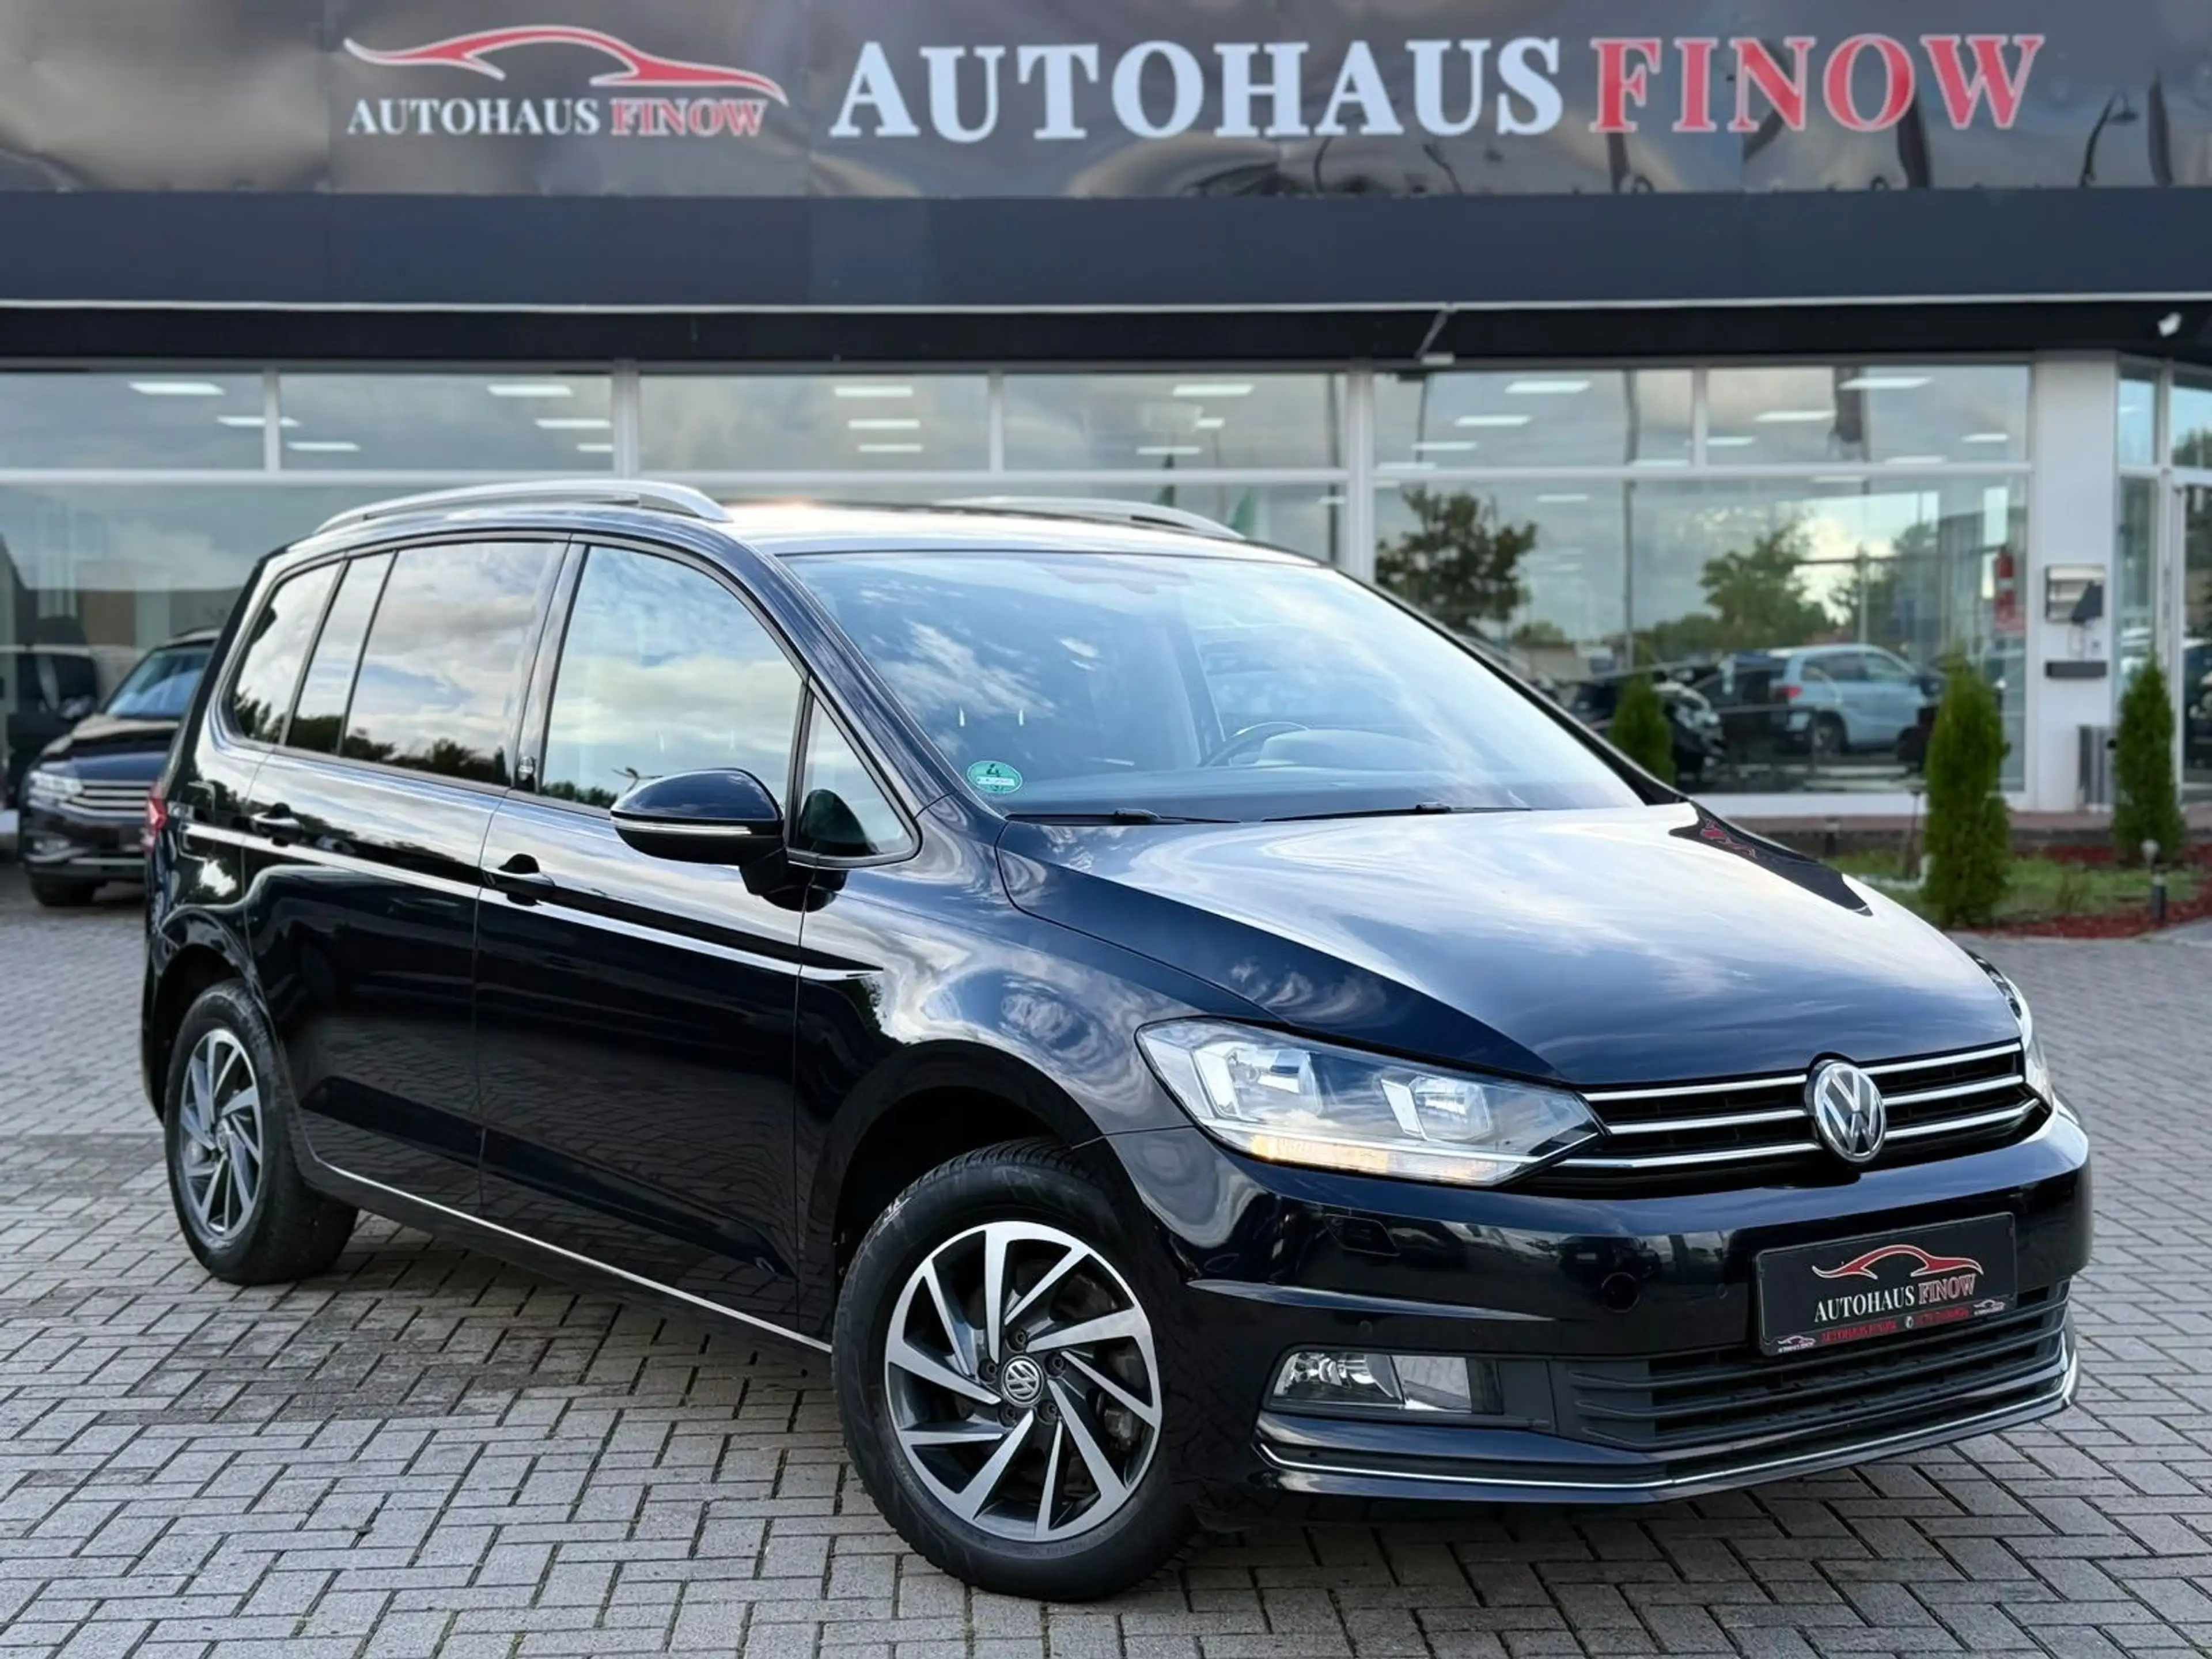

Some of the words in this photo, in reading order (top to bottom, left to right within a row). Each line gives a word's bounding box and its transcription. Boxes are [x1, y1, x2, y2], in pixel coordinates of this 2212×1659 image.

[828, 37, 1565, 143] AUTOHAUS
[1589, 33, 2046, 133] FINOW
[347, 99, 599, 135] AUTOHAUS
[610, 98, 768, 136] FINOW
[1814, 1285, 1915, 1323] AUTOHAUS
[1918, 1273, 1976, 1305] FINOW
